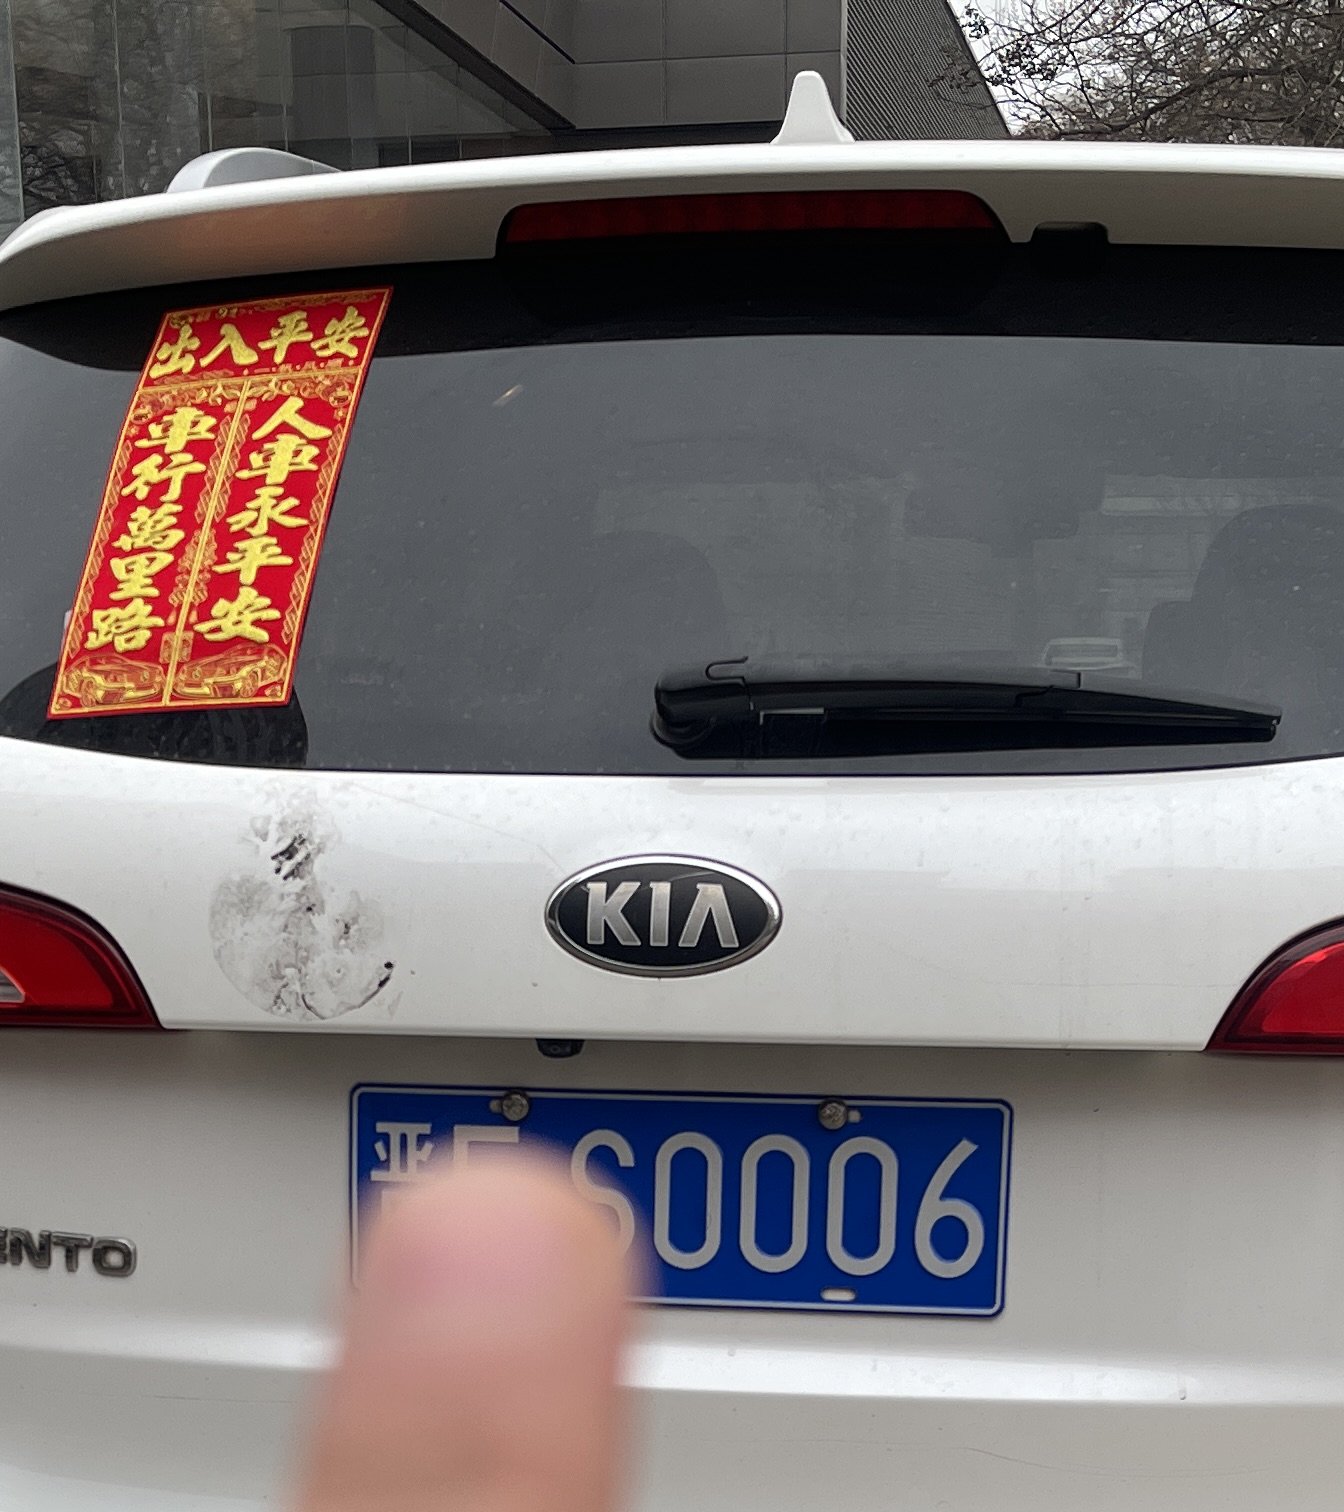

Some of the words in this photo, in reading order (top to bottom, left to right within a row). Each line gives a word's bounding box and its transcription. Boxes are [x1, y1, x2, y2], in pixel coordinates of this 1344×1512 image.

[149, 306, 370, 379] 出入平安
[193, 396, 333, 643] 人車永平安
[586, 881, 740, 948] KIA
[370, 1121, 985, 1280] S0006
